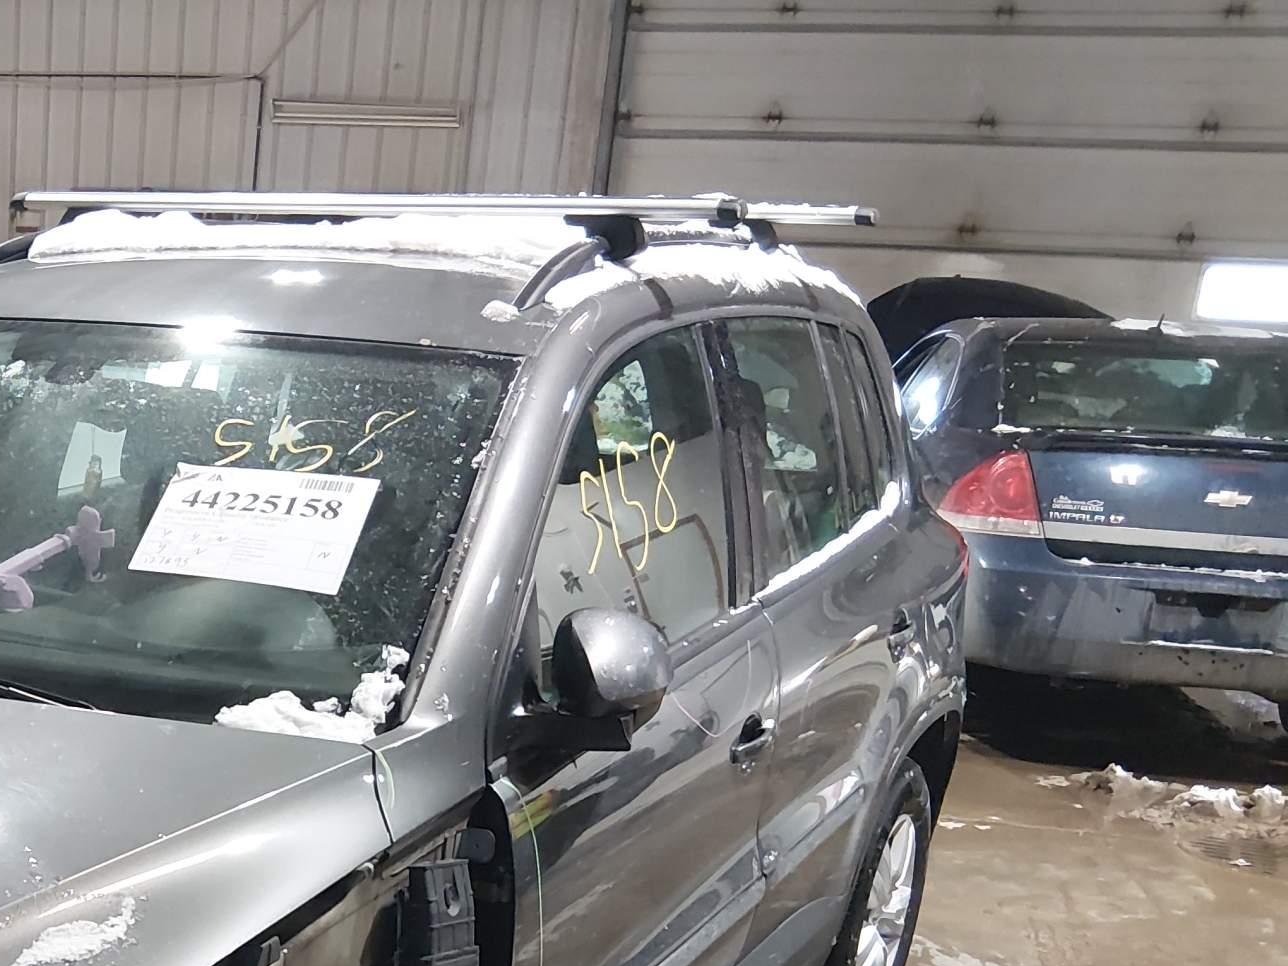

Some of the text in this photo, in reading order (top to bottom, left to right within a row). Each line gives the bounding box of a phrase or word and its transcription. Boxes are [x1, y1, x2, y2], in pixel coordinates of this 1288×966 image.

[214, 409, 418, 472] 5158
[181, 489, 343, 521] 44225158
[579, 431, 677, 575] 5158
[1049, 511, 1106, 523] IMPALA
